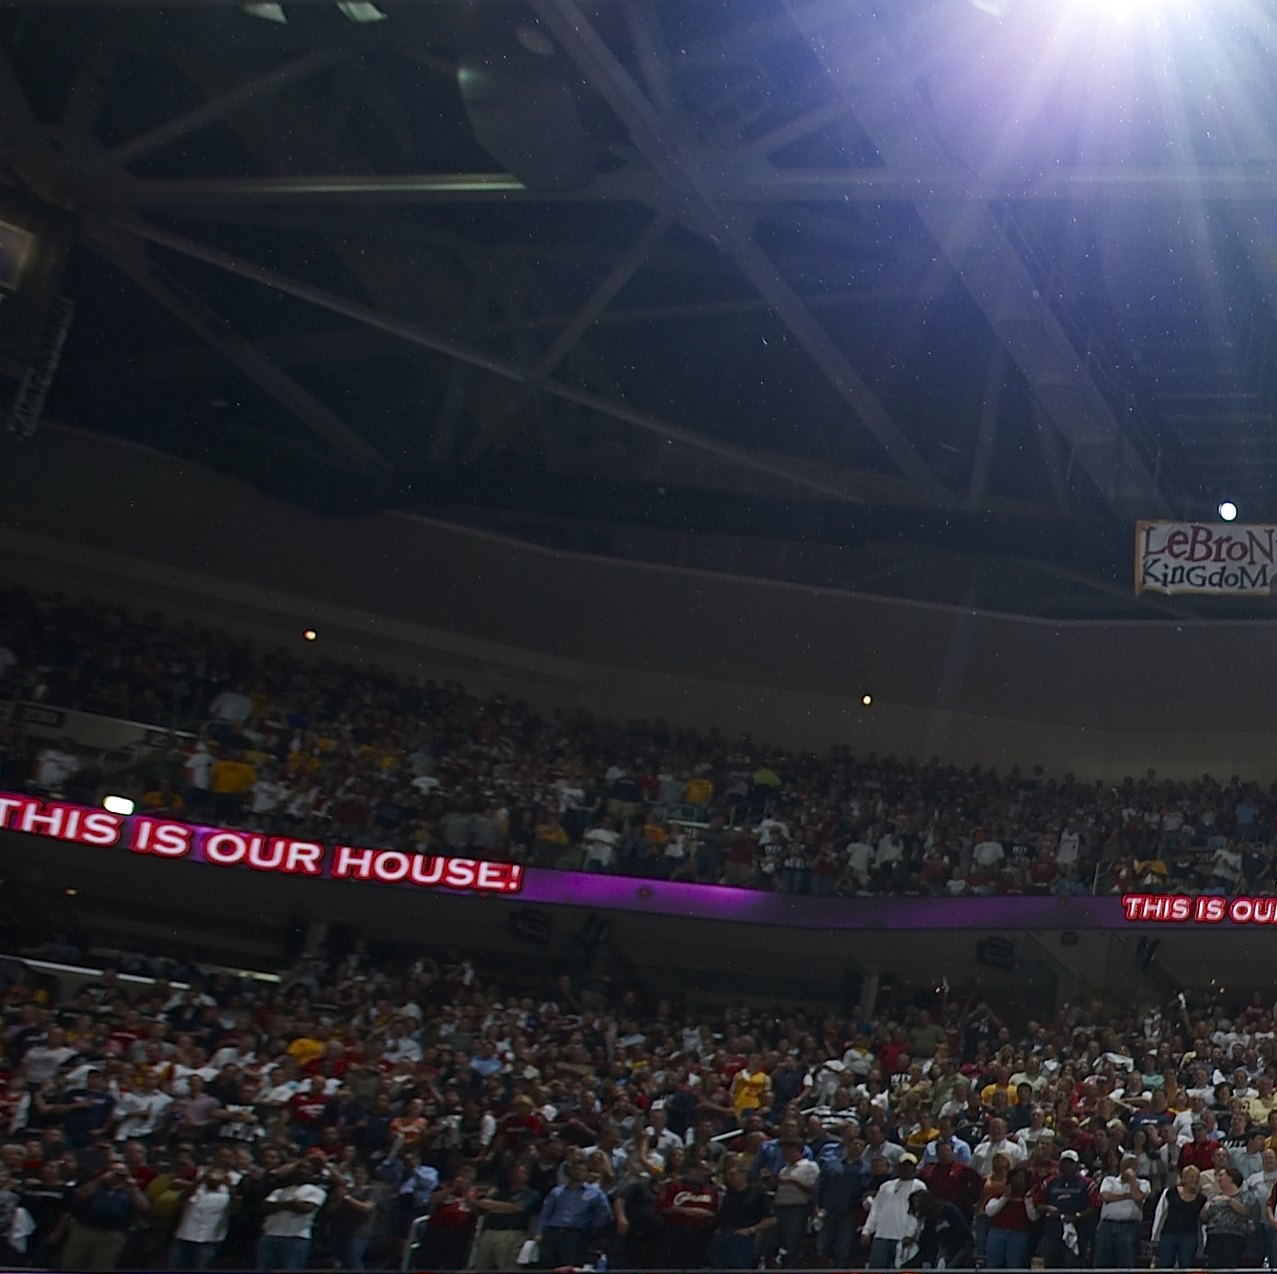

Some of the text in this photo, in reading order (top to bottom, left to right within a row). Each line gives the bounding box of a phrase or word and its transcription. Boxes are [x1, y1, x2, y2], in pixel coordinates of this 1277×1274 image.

[0, 800, 521, 891] THIS IS OUR HOUSE!
[1125, 896, 1188, 920] THIS
[1197, 898, 1223, 920] IS
